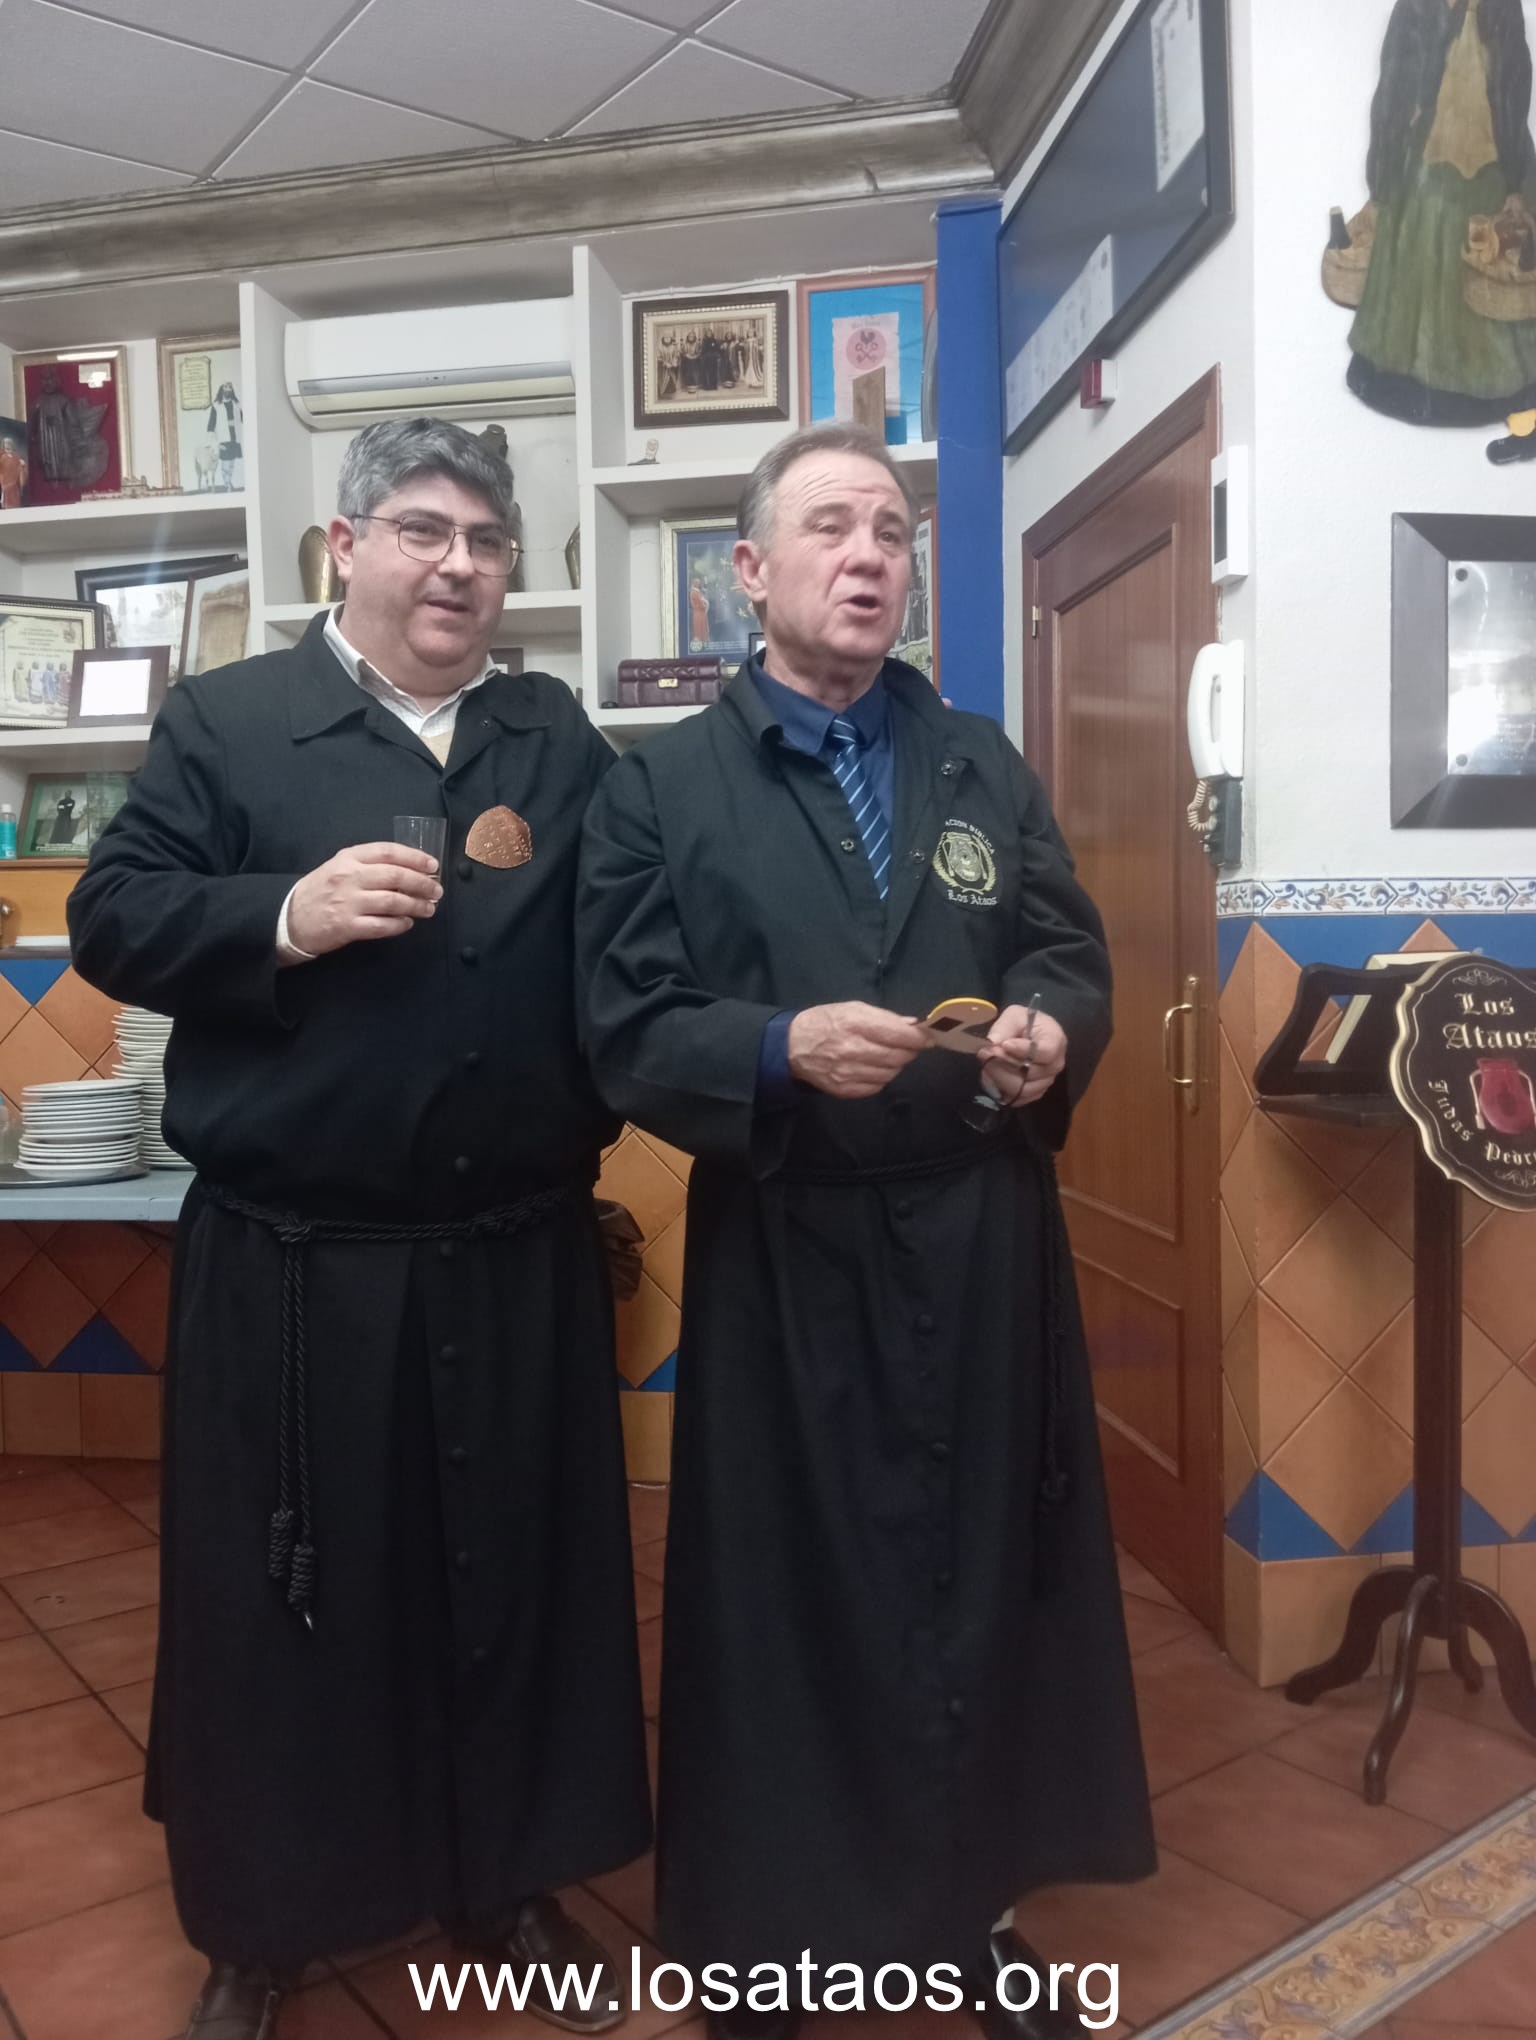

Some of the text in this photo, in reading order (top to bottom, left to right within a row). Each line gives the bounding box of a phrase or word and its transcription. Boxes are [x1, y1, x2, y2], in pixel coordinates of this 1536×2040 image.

[947, 889, 968, 903] Los
[1454, 992, 1515, 1015] Los
[1442, 1022, 1536, 1049] Ataos
